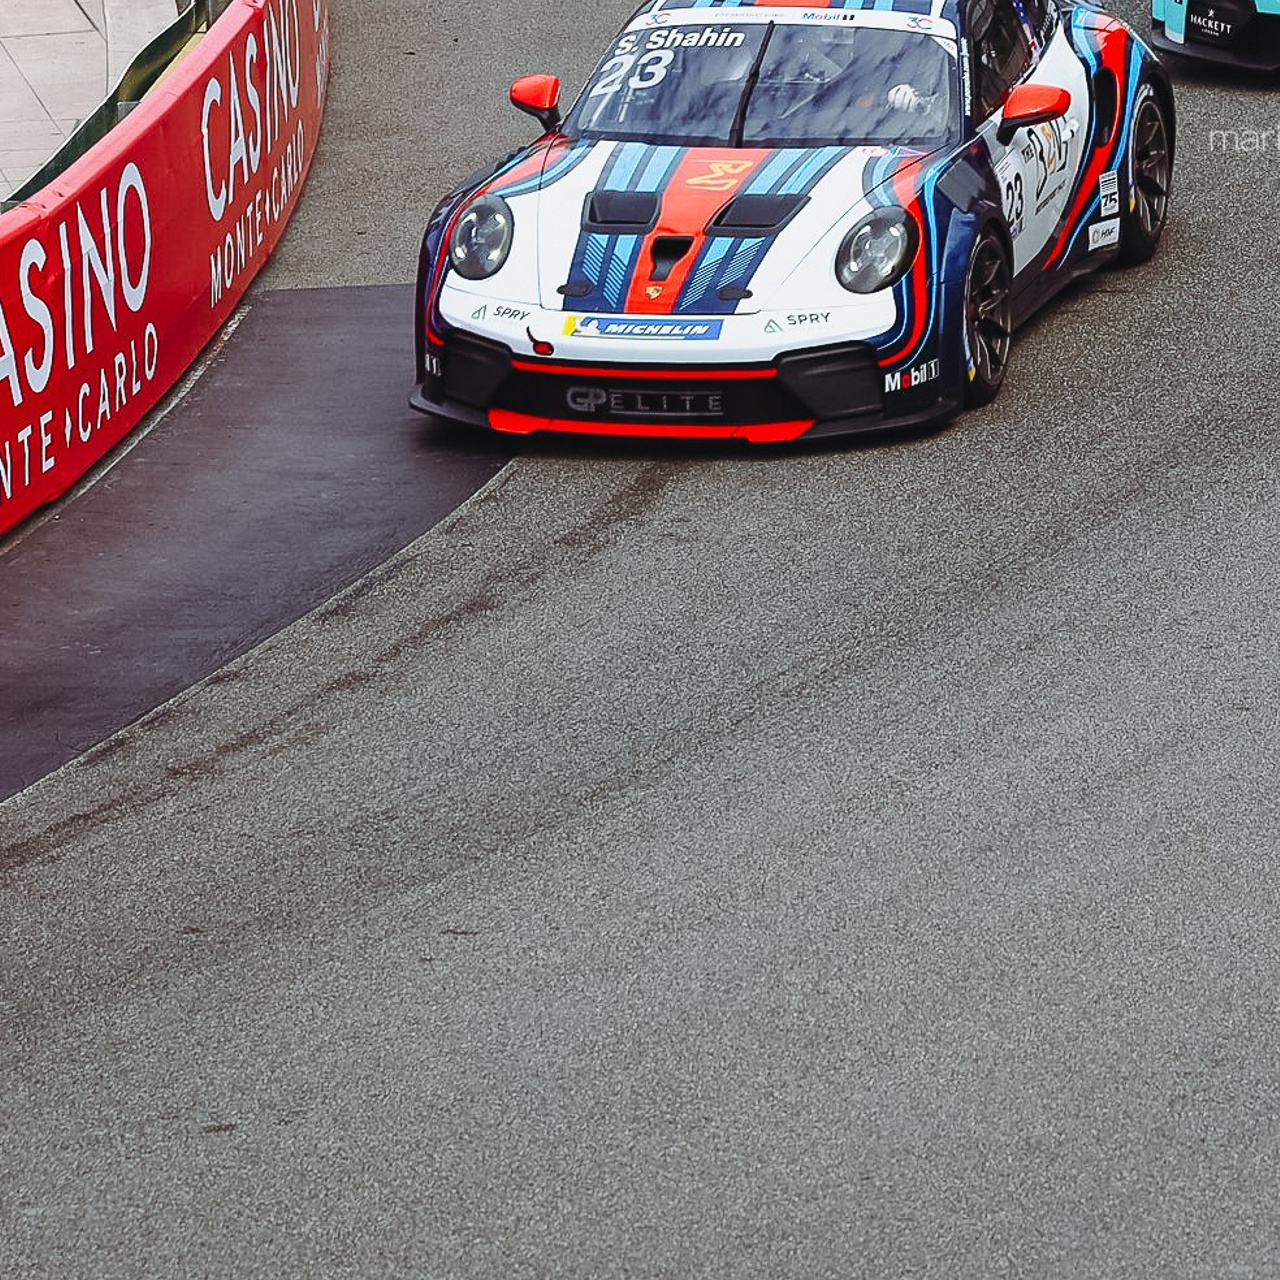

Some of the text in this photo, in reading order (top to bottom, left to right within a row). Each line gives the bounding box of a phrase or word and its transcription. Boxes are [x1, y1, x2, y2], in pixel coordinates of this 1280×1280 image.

[1190, 13, 1233, 35] HACKETT
[613, 27, 746, 57] S. Shahin
[588, 49, 676, 98] 23
[210, 119, 304, 308] MONTE CARLO
[0, 161, 152, 407] ASINO
[491, 305, 532, 322] SPRY
[786, 311, 832, 327] SPRY
[604, 322, 712, 337] MICHELIN
[884, 367, 927, 395] Mobil
[0, 322, 158, 500] NTE CARLO
